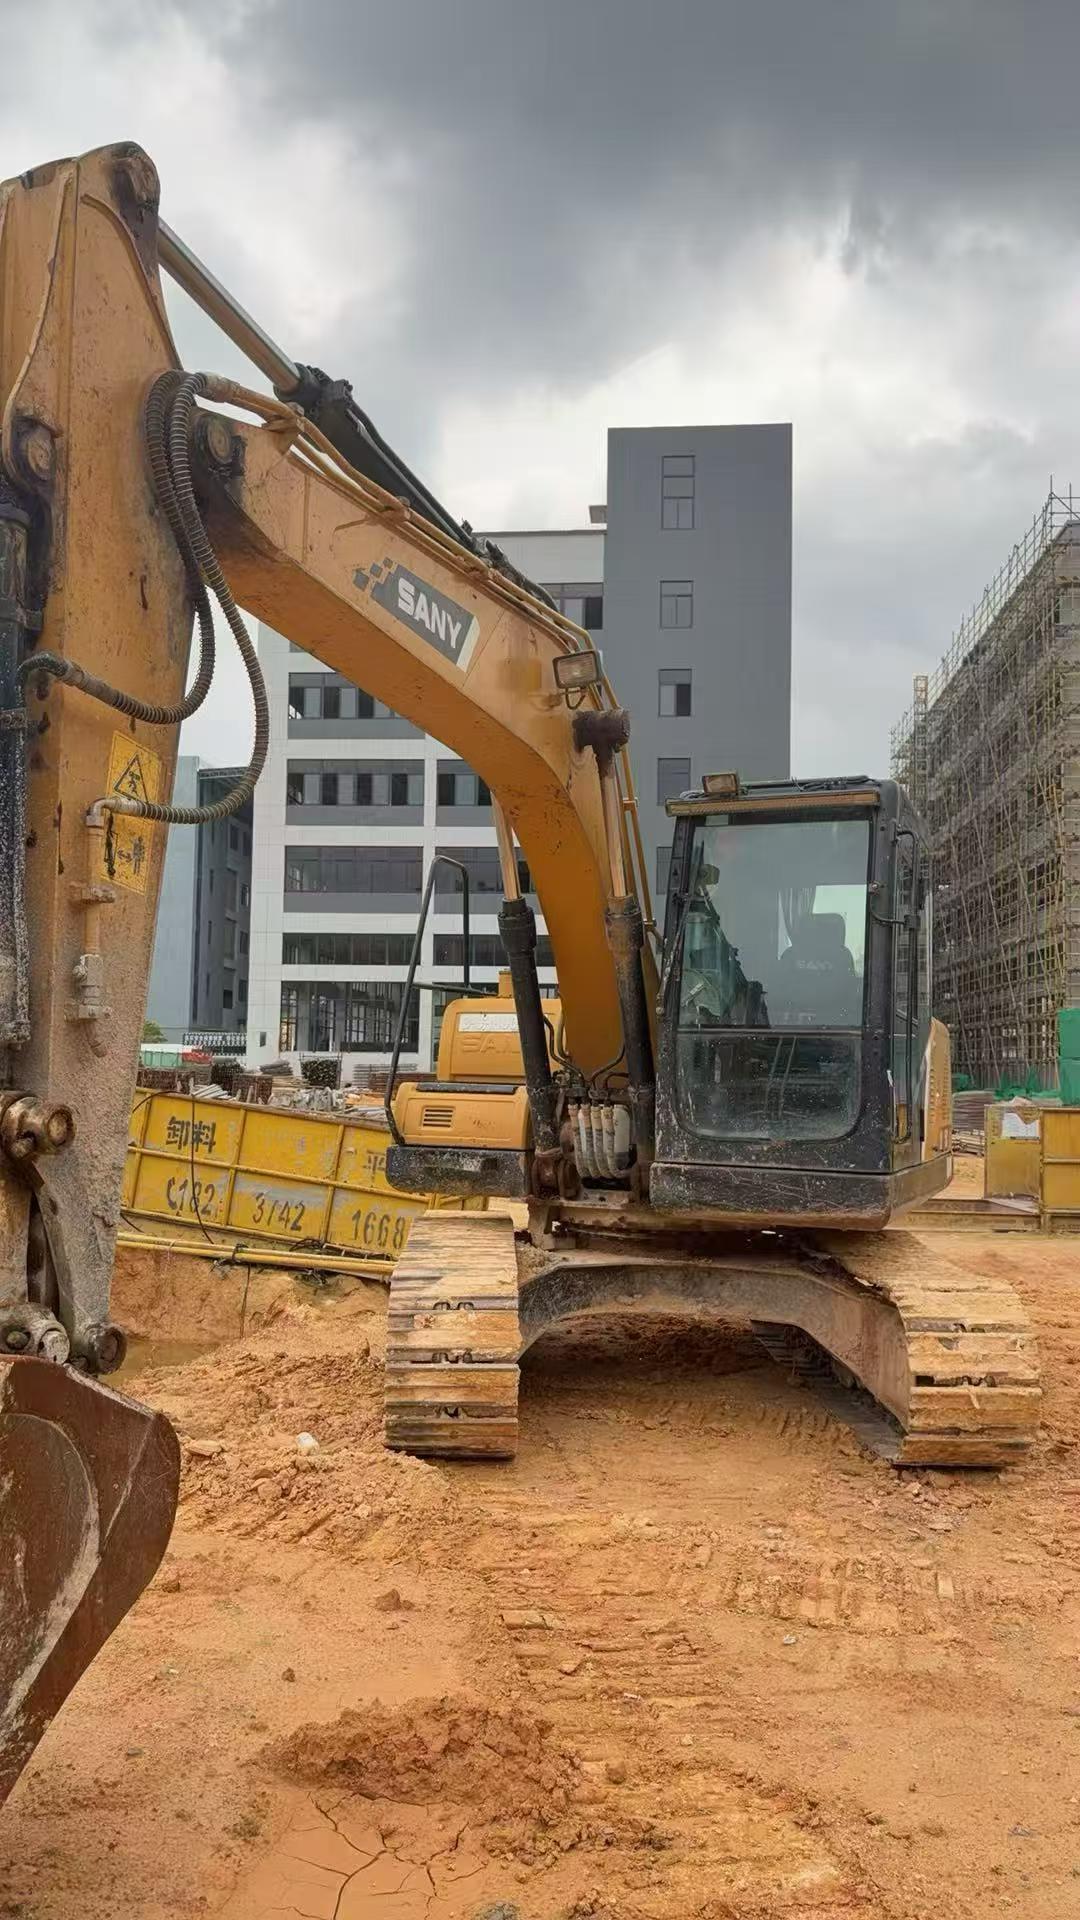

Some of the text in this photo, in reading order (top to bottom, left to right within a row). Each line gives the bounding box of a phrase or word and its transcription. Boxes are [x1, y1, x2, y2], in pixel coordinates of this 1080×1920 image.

[398, 577, 462, 649] SANY
[165, 1116, 216, 1153] 卸料
[351, 1208, 406, 1249] 1668
